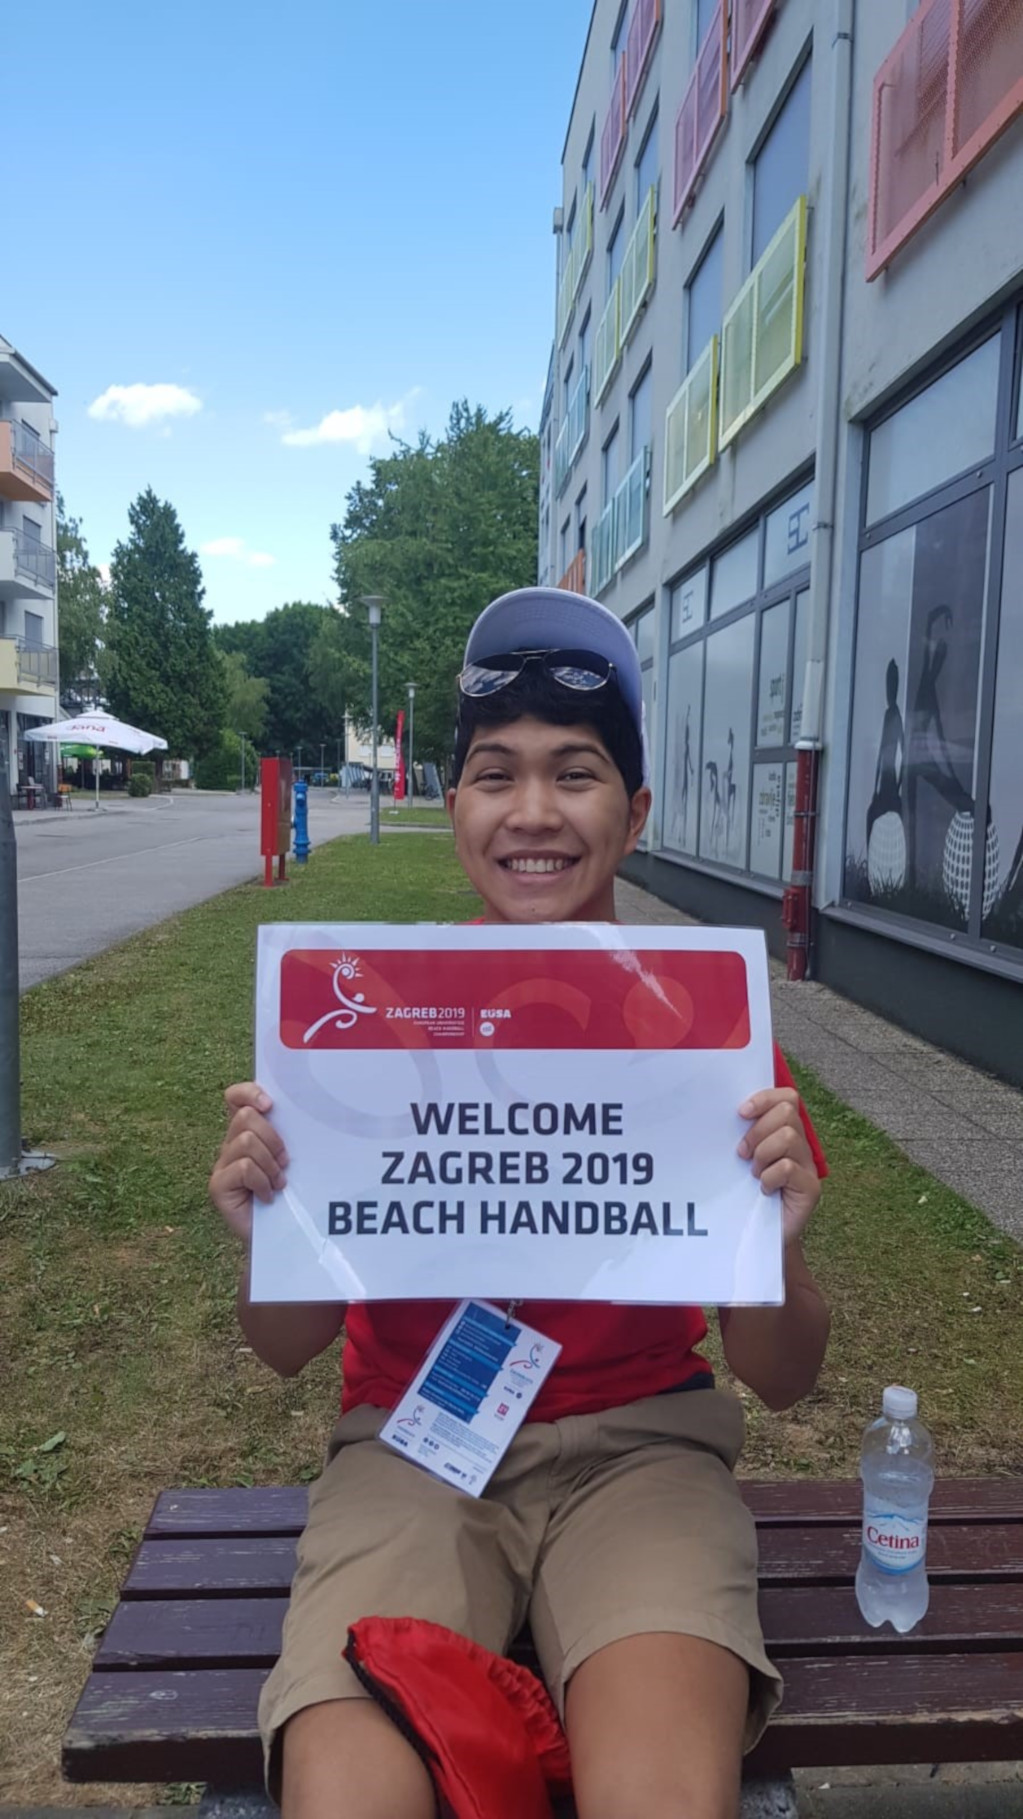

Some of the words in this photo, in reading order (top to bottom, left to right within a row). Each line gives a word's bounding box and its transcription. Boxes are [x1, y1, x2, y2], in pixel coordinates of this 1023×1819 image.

[411, 1102, 623, 1135] WELCOME
[381, 1151, 550, 1185] ZAGREB
[562, 1151, 654, 1185] 2019
[328, 1201, 465, 1236] BEACH
[480, 1201, 708, 1236] HANDBALL
[866, 1525, 920, 1549] Cetina
